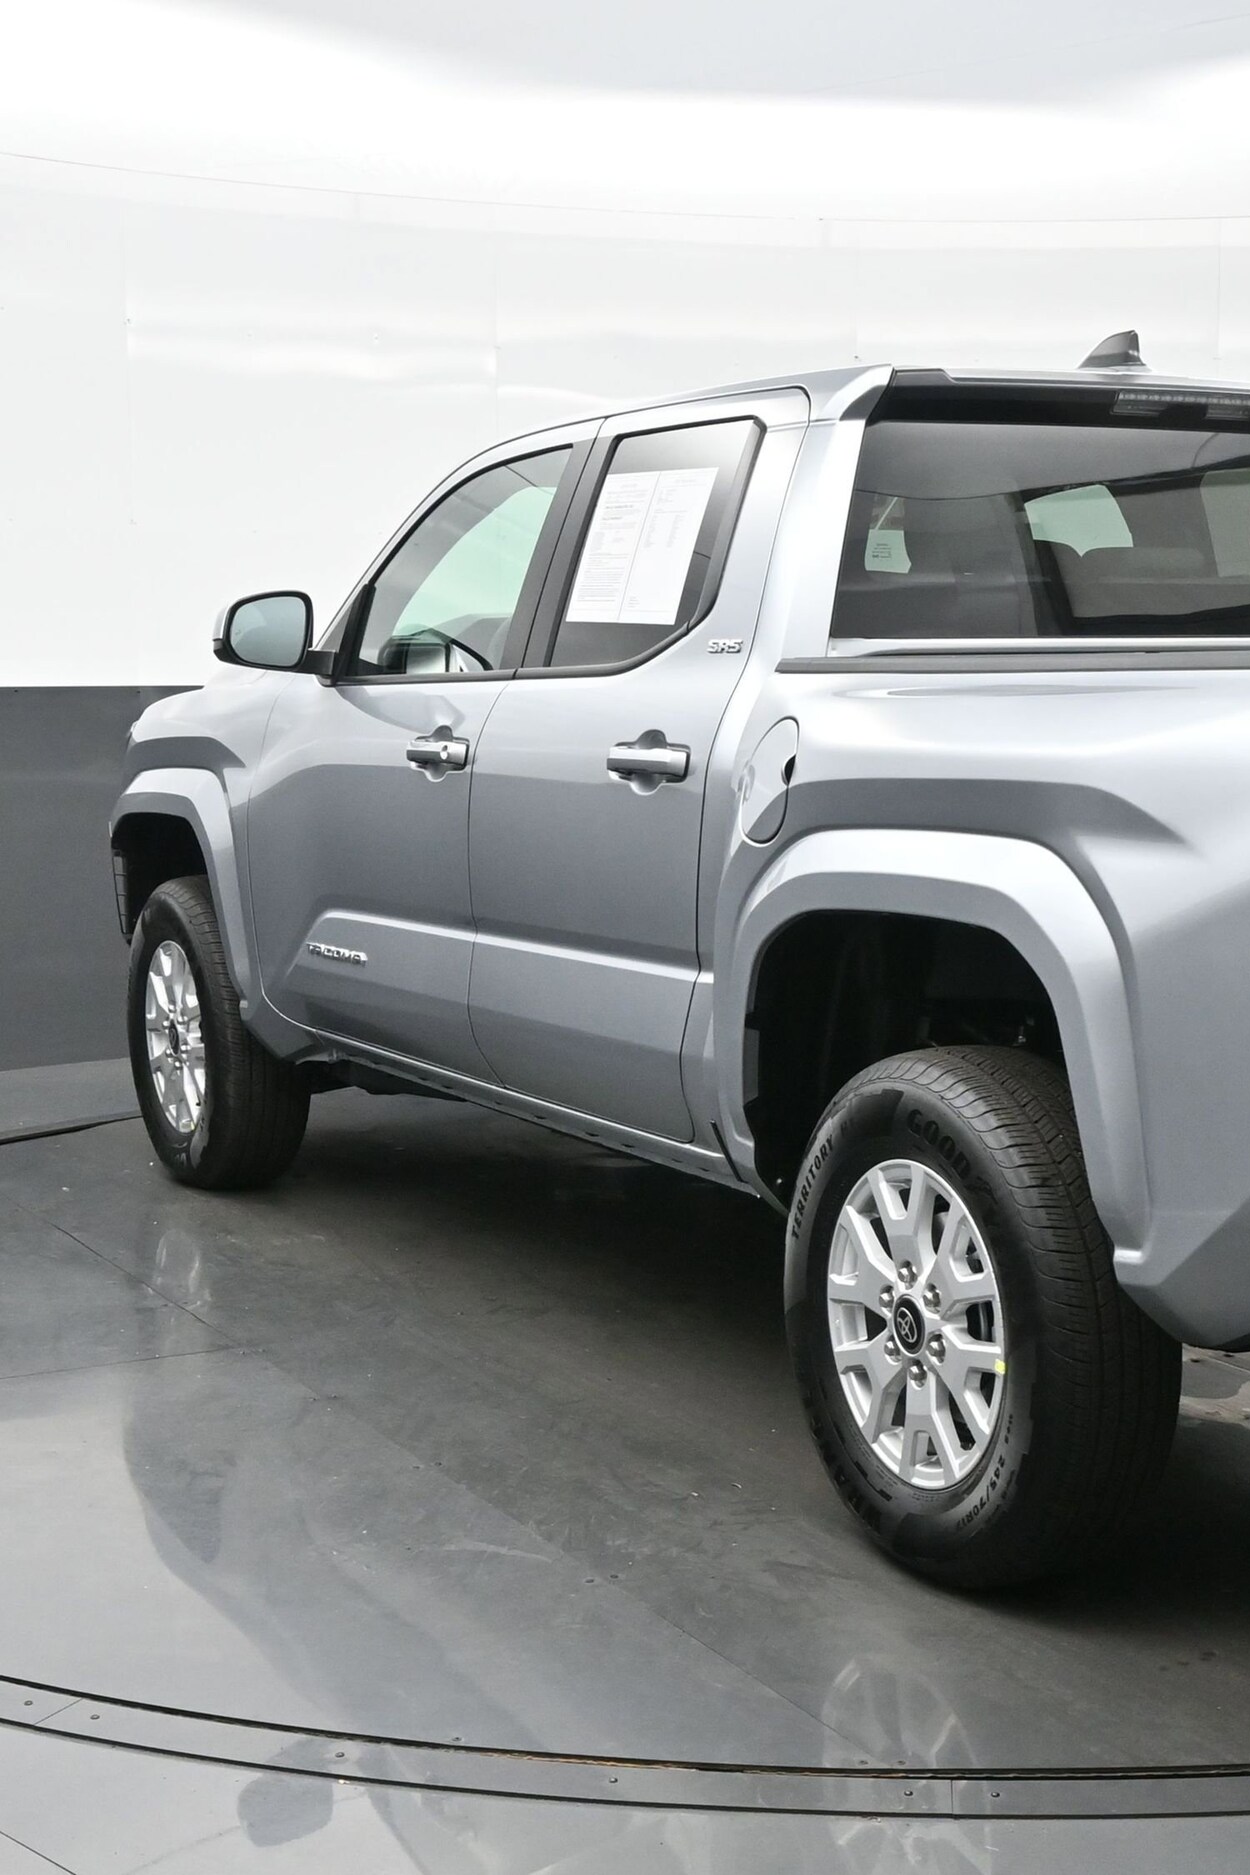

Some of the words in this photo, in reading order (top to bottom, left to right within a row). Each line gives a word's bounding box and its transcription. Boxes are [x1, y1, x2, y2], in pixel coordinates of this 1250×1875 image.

[707, 638, 743, 654] SR5
[305, 941, 368, 967] TACOMA
[792, 1134, 835, 1240] TERRITORY
